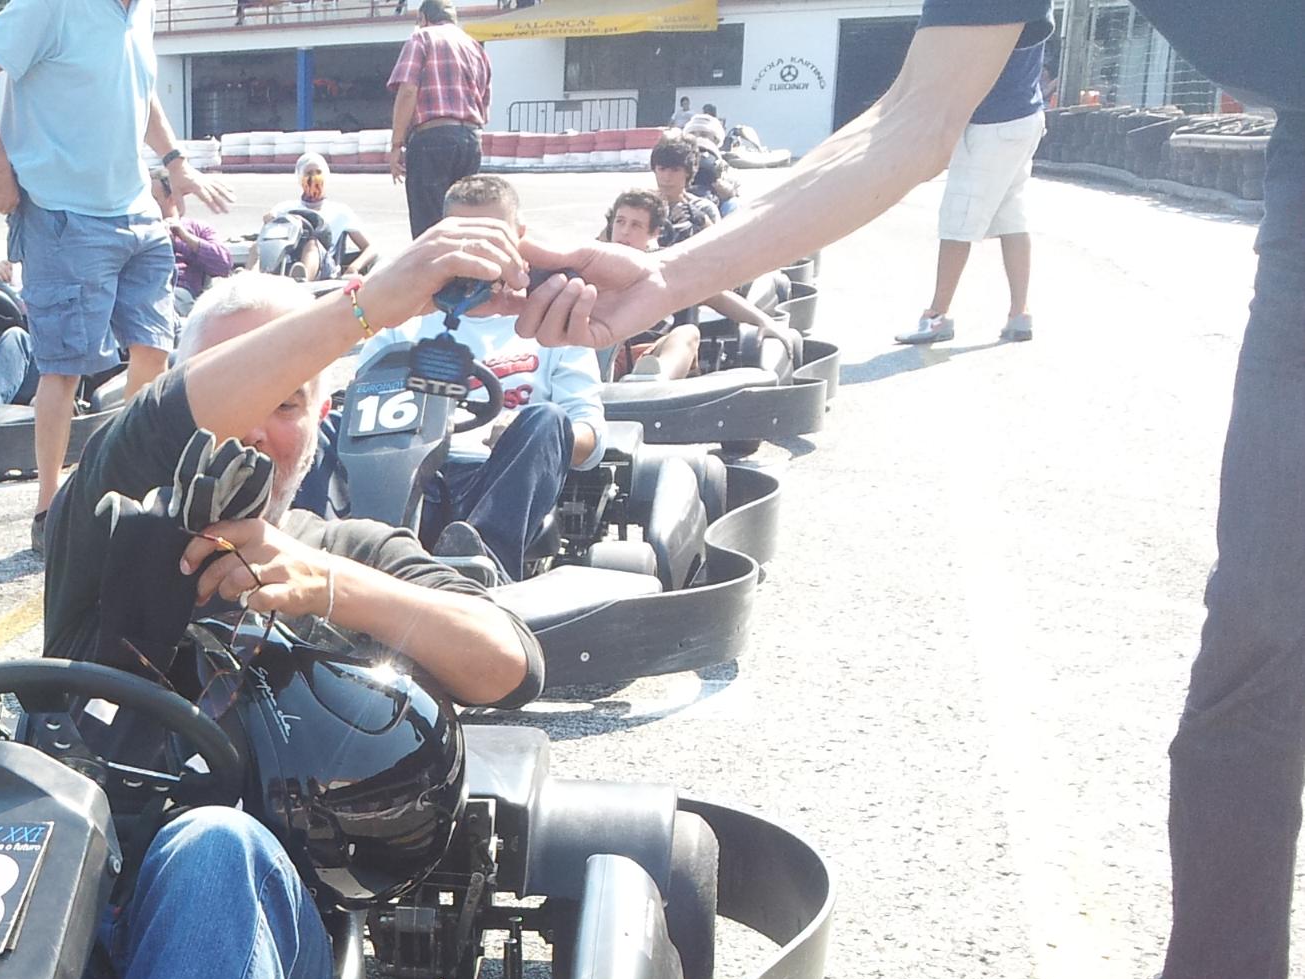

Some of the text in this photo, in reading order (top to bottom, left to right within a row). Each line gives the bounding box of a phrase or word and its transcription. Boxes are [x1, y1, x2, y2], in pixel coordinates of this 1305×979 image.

[357, 390, 418, 432] 16
[2, 826, 45, 843] XXI
[13, 843, 41, 851] futuro
